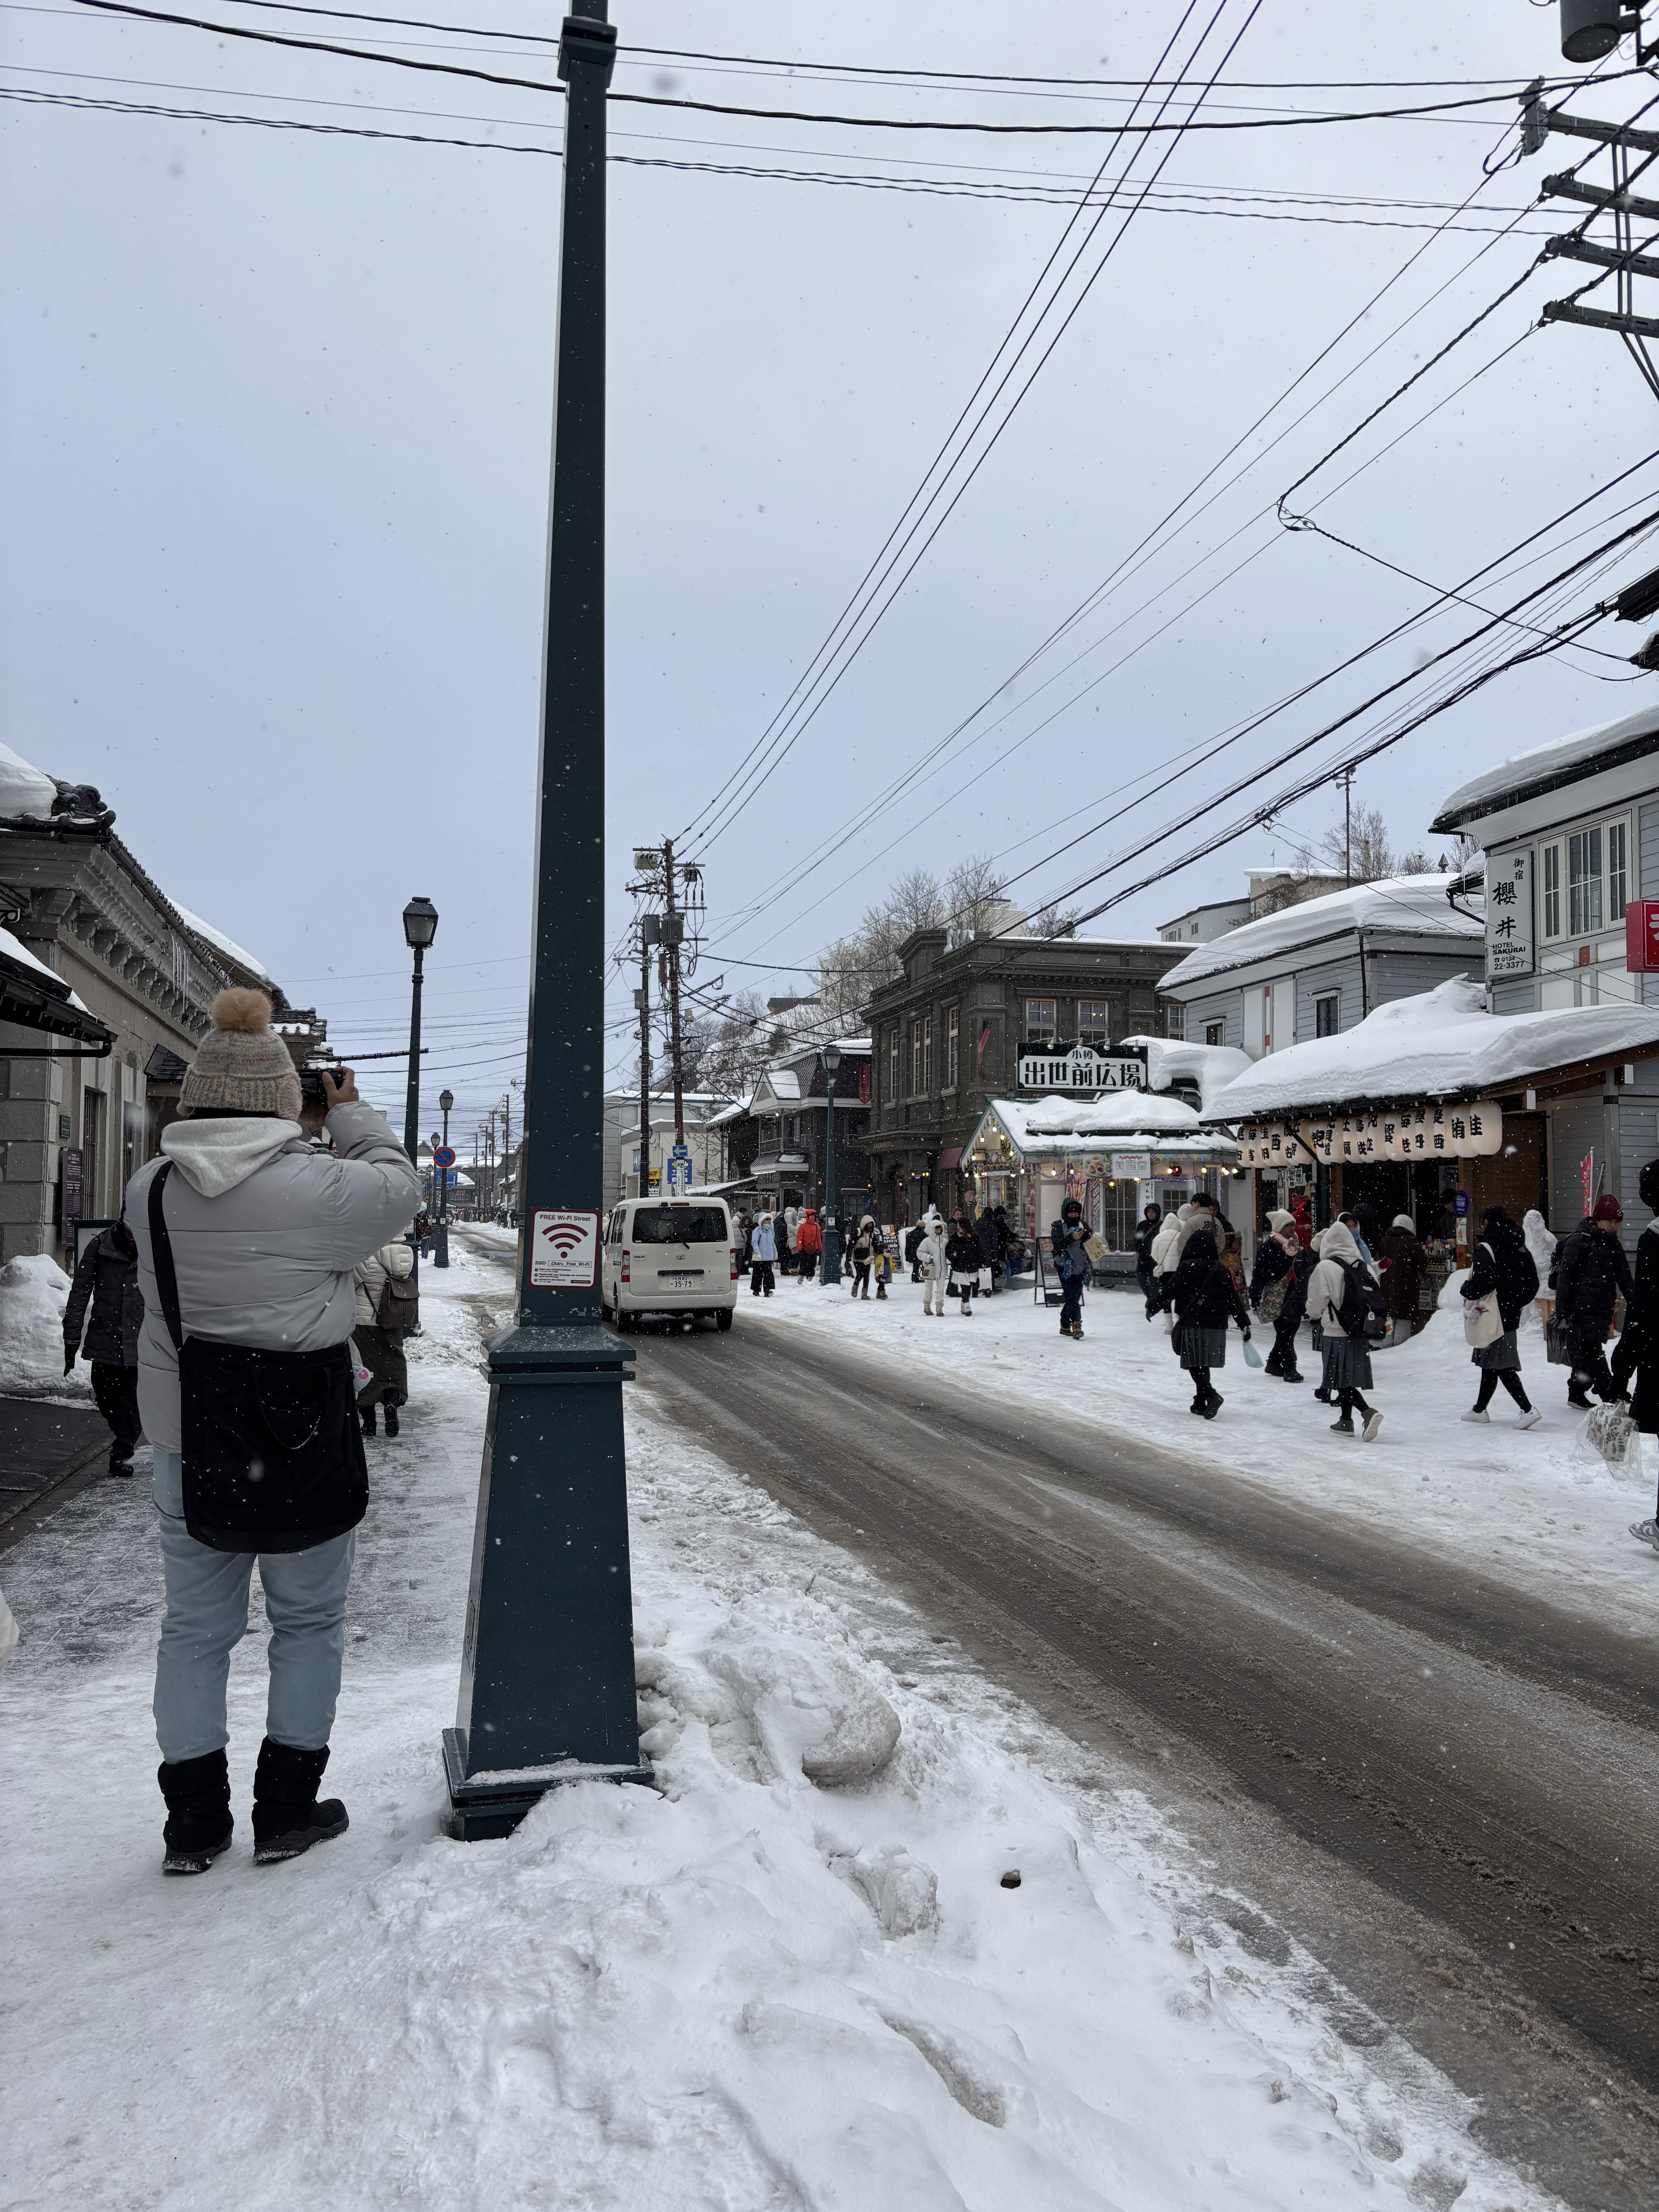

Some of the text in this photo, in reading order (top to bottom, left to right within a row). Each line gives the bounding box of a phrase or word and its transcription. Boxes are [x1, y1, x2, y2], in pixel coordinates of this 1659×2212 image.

[1513, 858, 1524, 881] 御宿
[1492, 881, 1518, 939] 櫻井
[1493, 946, 1526, 955] SAKURAI
[1494, 960, 1524, 970] 22-3377
[1072, 1050, 1093, 1060] 小樽
[1024, 1061, 1141, 1087] 出世前広場
